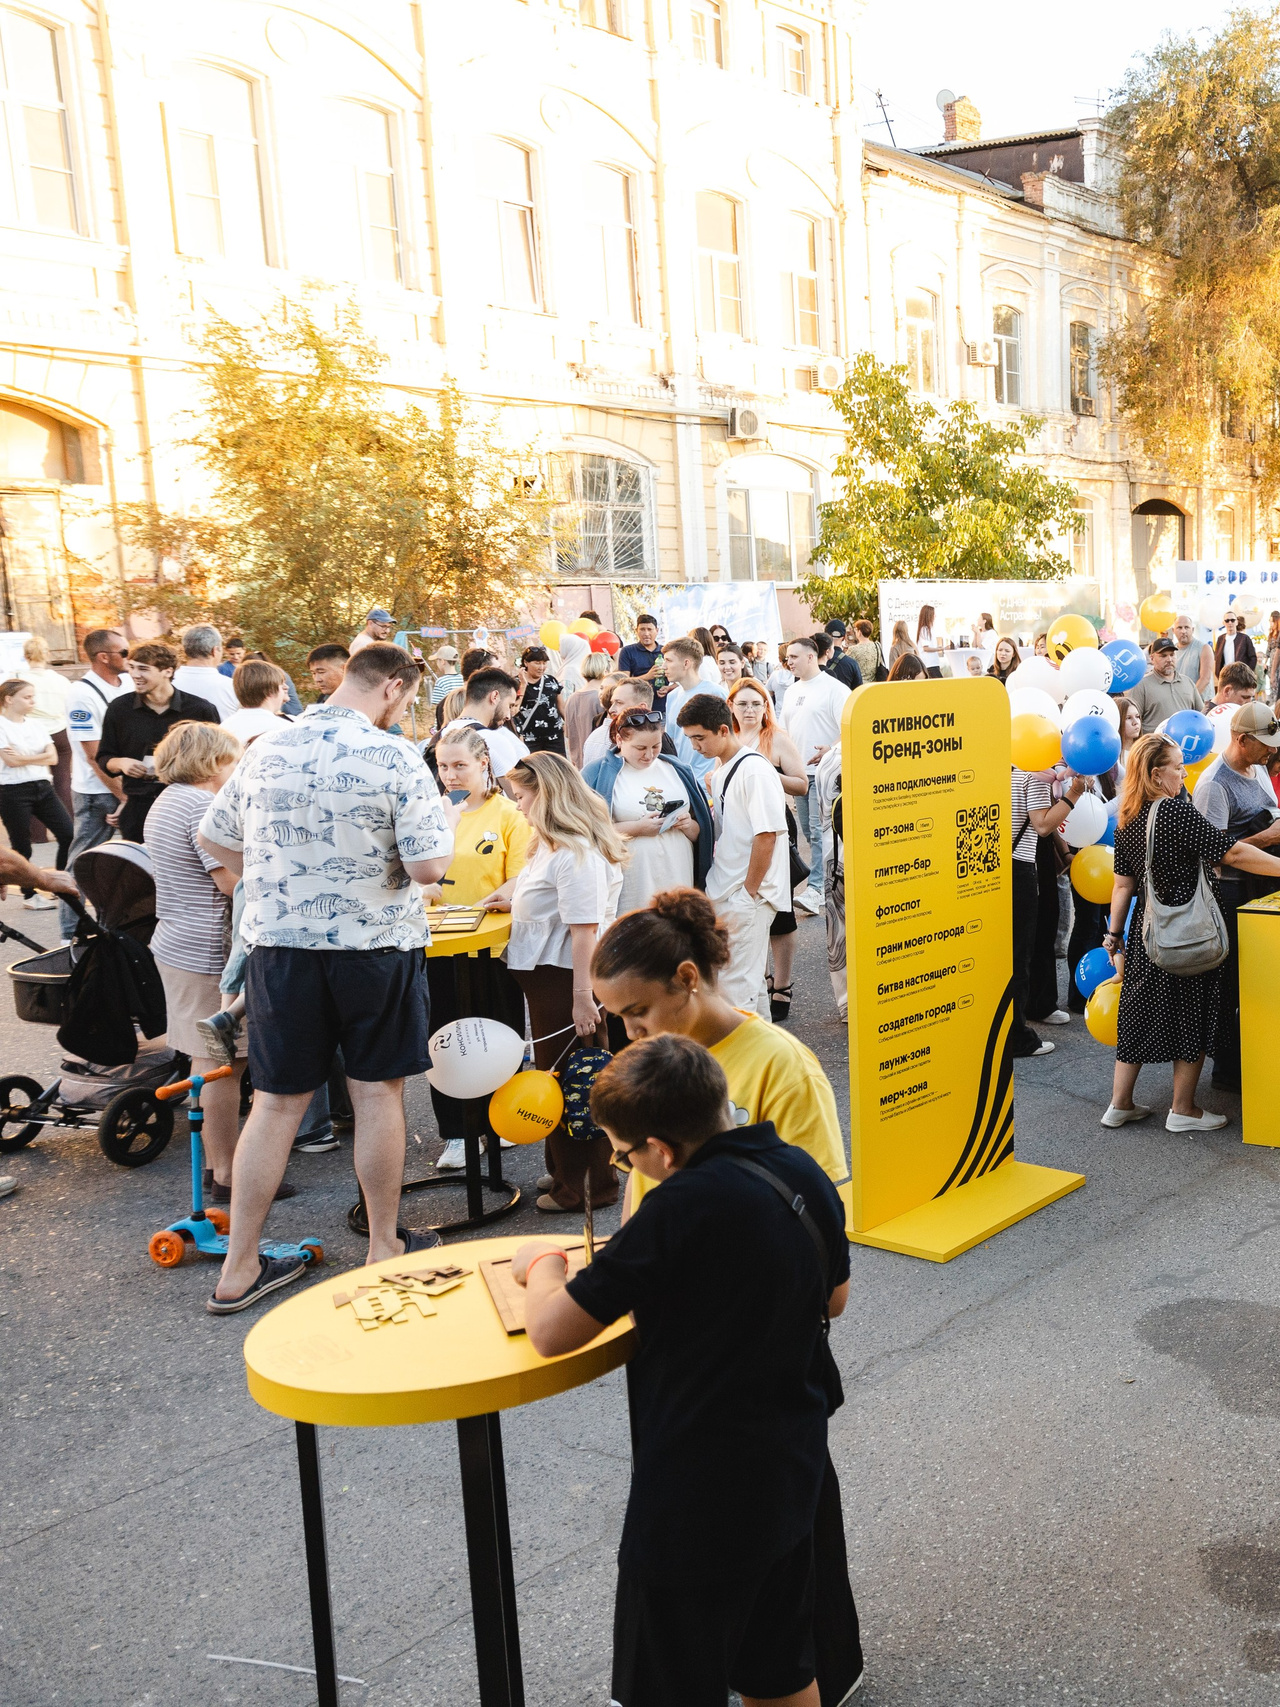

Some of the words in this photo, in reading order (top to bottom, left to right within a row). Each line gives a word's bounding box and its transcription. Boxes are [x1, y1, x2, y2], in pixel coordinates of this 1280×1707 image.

[872, 712, 955, 735] активности
[872, 736, 963, 763] бренд-зоны
[873, 783, 894, 795] зона
[896, 773, 956, 791] подключения
[873, 822, 914, 839] арт-зона
[874, 857, 931, 878] глиттер-бар
[875, 899, 921, 919] фотоспот
[876, 941, 903, 958] грани
[904, 935, 933, 949] моего
[934, 925, 964, 941] города
[877, 981, 903, 995] битва
[905, 964, 957, 987] настоящего
[878, 1012, 924, 1034] создатель
[925, 1001, 956, 1019] города
[878, 1045, 931, 1072] лаунж-зона
[879, 1080, 928, 1106] мерч-зона
[516, 1107, 554, 1130] билайн
